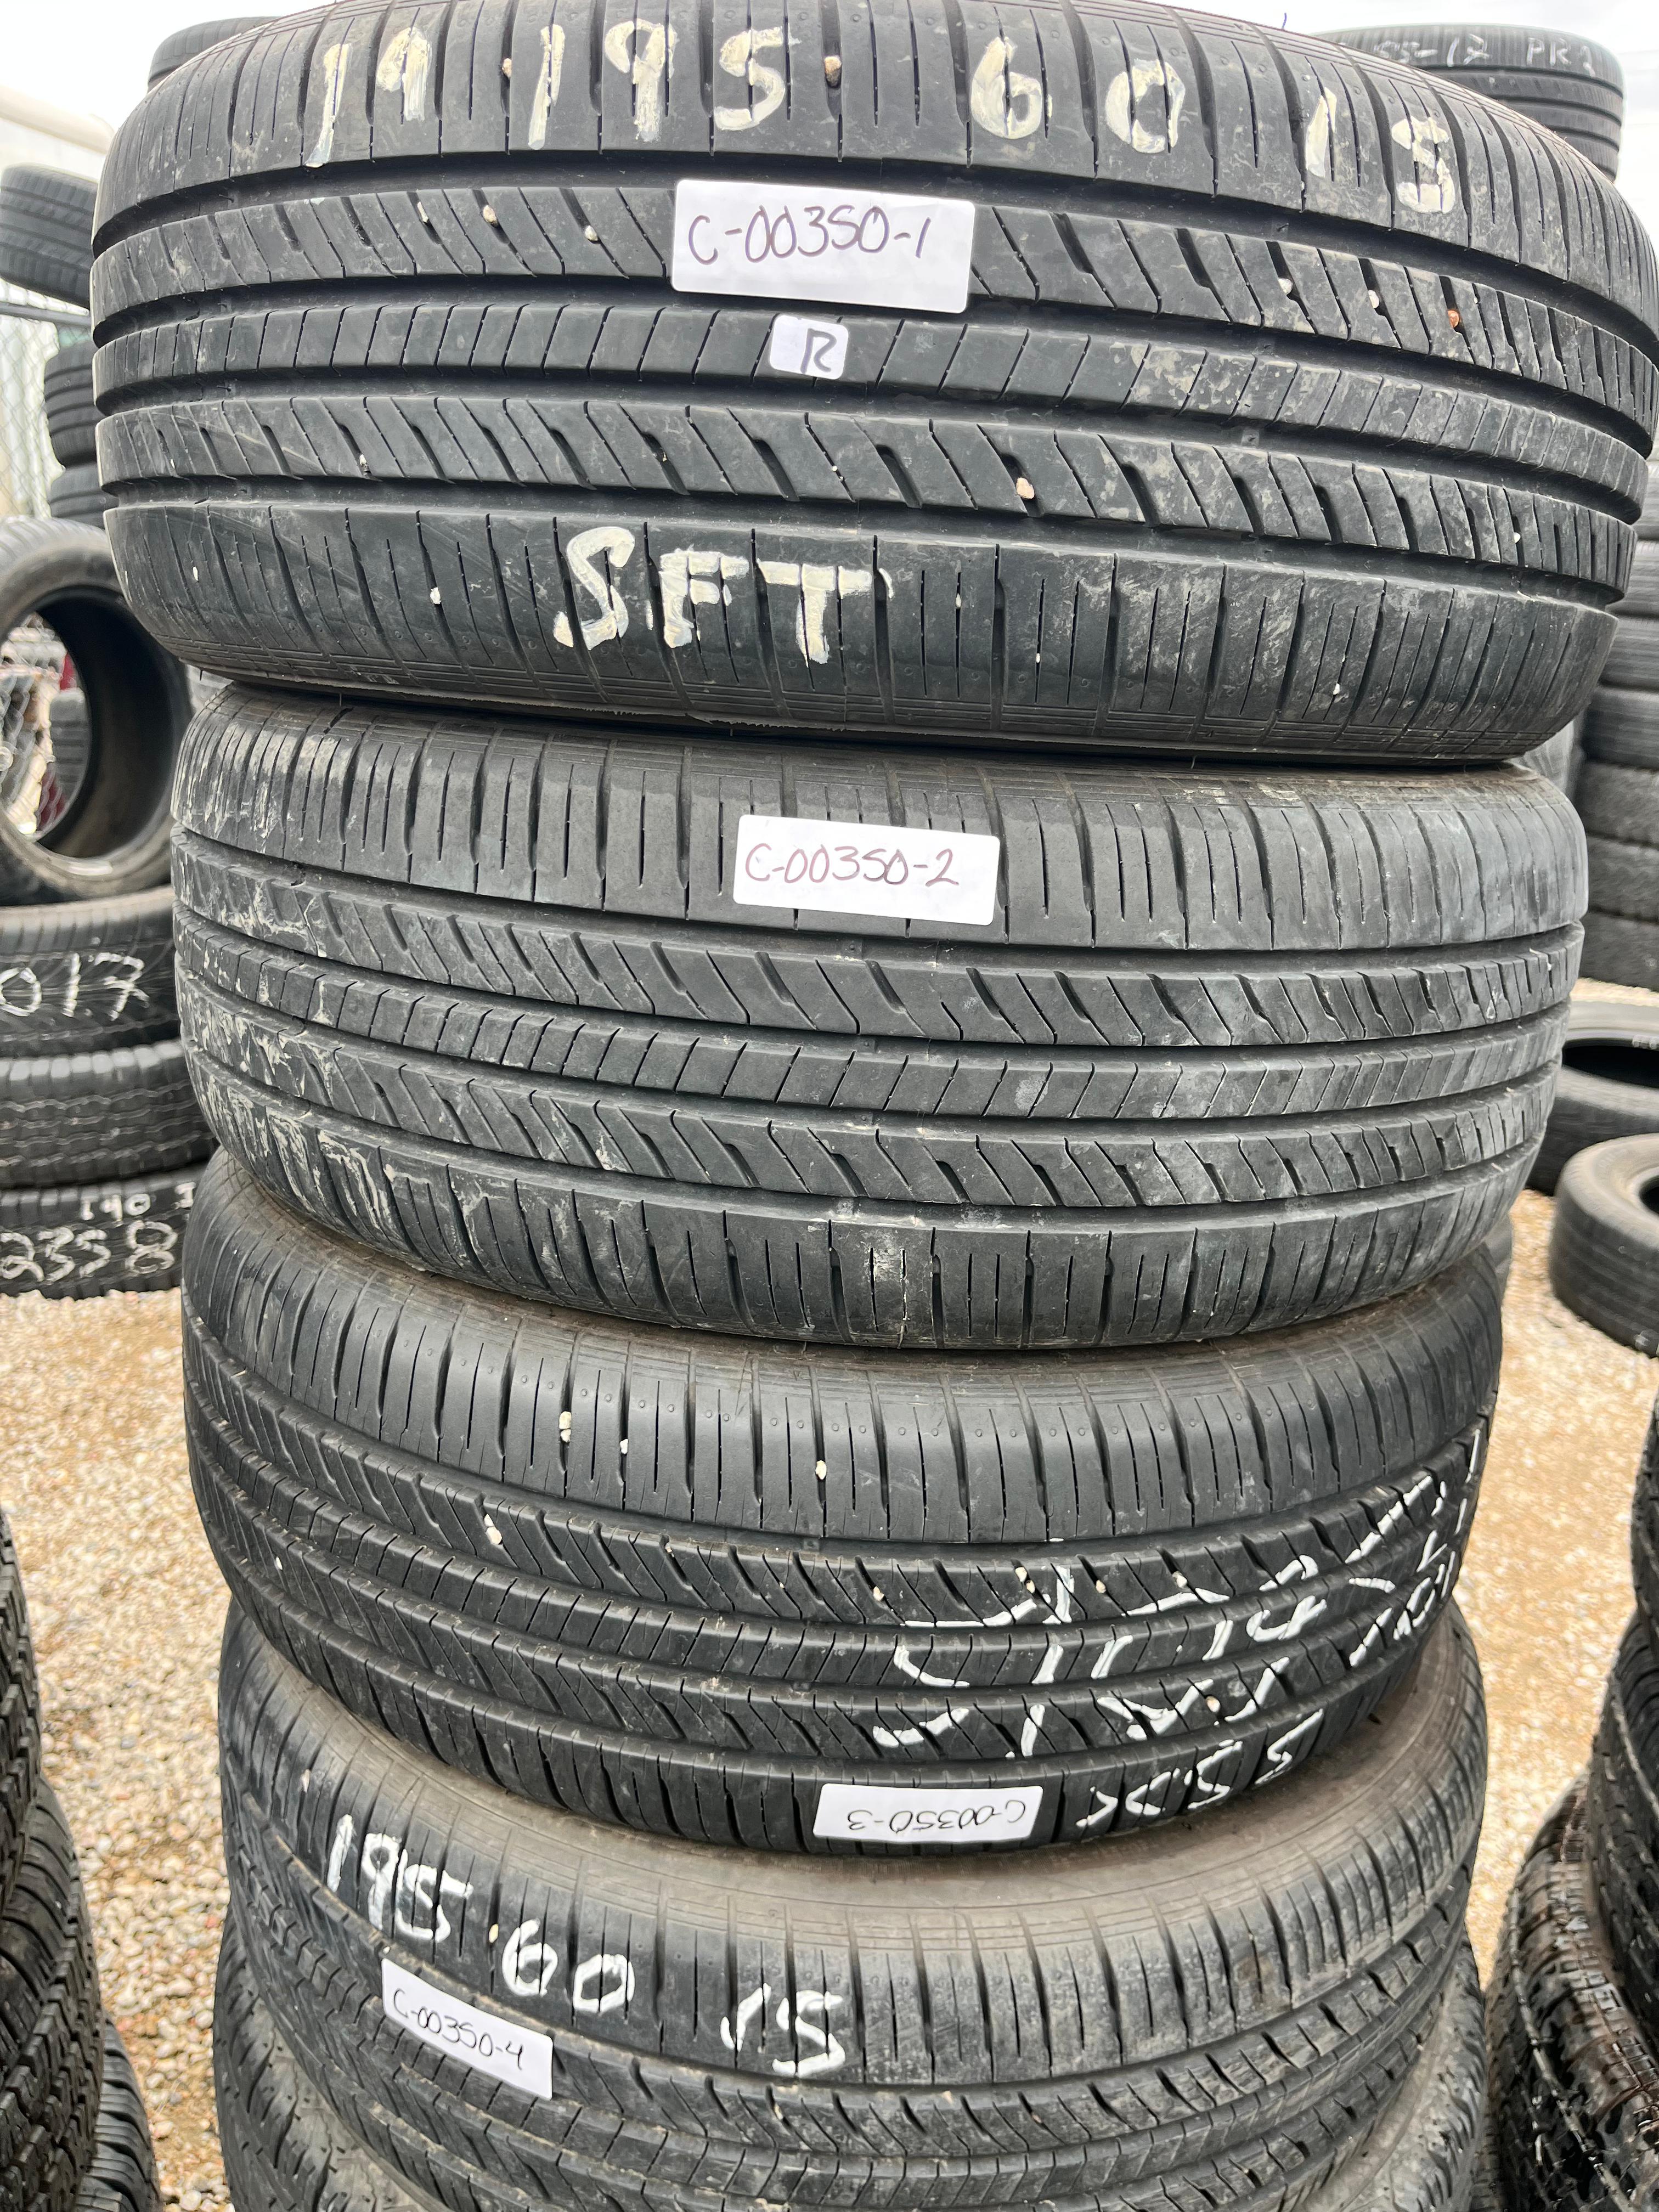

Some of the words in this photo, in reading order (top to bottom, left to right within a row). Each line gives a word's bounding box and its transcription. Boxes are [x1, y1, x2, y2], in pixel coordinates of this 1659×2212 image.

[971, 35, 1187, 154] 60
[688, 204, 932, 266] C-00350-1
[745, 843, 960, 888] C-00350-2
[847, 1799, 1026, 1834] C-00350-3
[326, 1813, 474, 1942] 195
[501, 1918, 636, 2015] 60
[393, 1988, 523, 2071] C-00350-4
